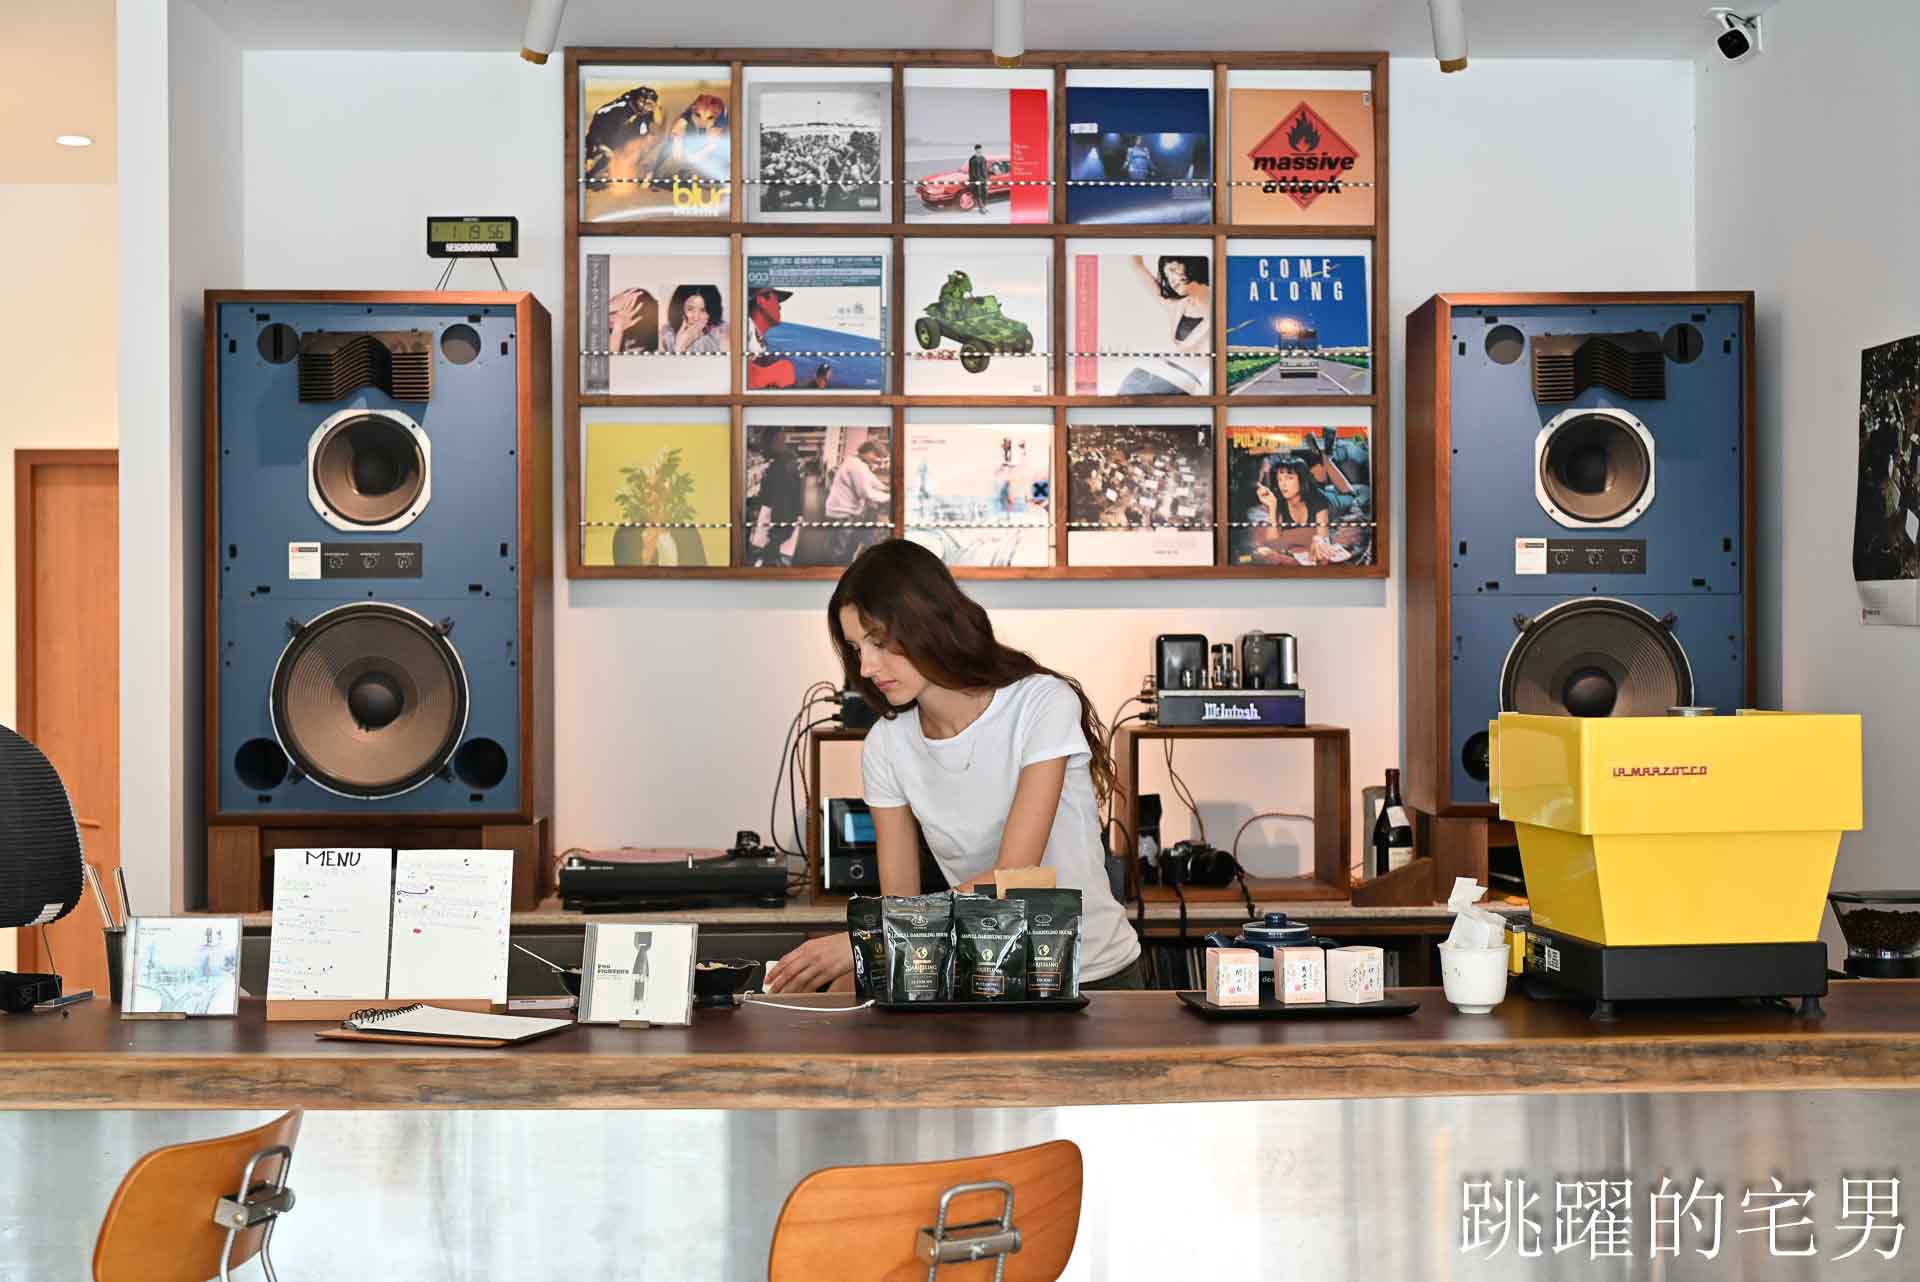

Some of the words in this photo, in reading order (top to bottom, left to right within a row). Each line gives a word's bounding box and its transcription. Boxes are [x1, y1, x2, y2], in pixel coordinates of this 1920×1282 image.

[1253, 152, 1354, 170] massive
[673, 175, 731, 208] blur
[1263, 176, 1342, 193] attack
[1259, 258, 1332, 278] COME
[1249, 281, 1344, 301] ALONG
[1233, 432, 1261, 448] PULP
[1202, 703, 1261, 720] McIntosh
[1613, 767, 1625, 776] LA
[1631, 766, 1707, 776] MARZOCCO
[305, 850, 361, 867] MENU
